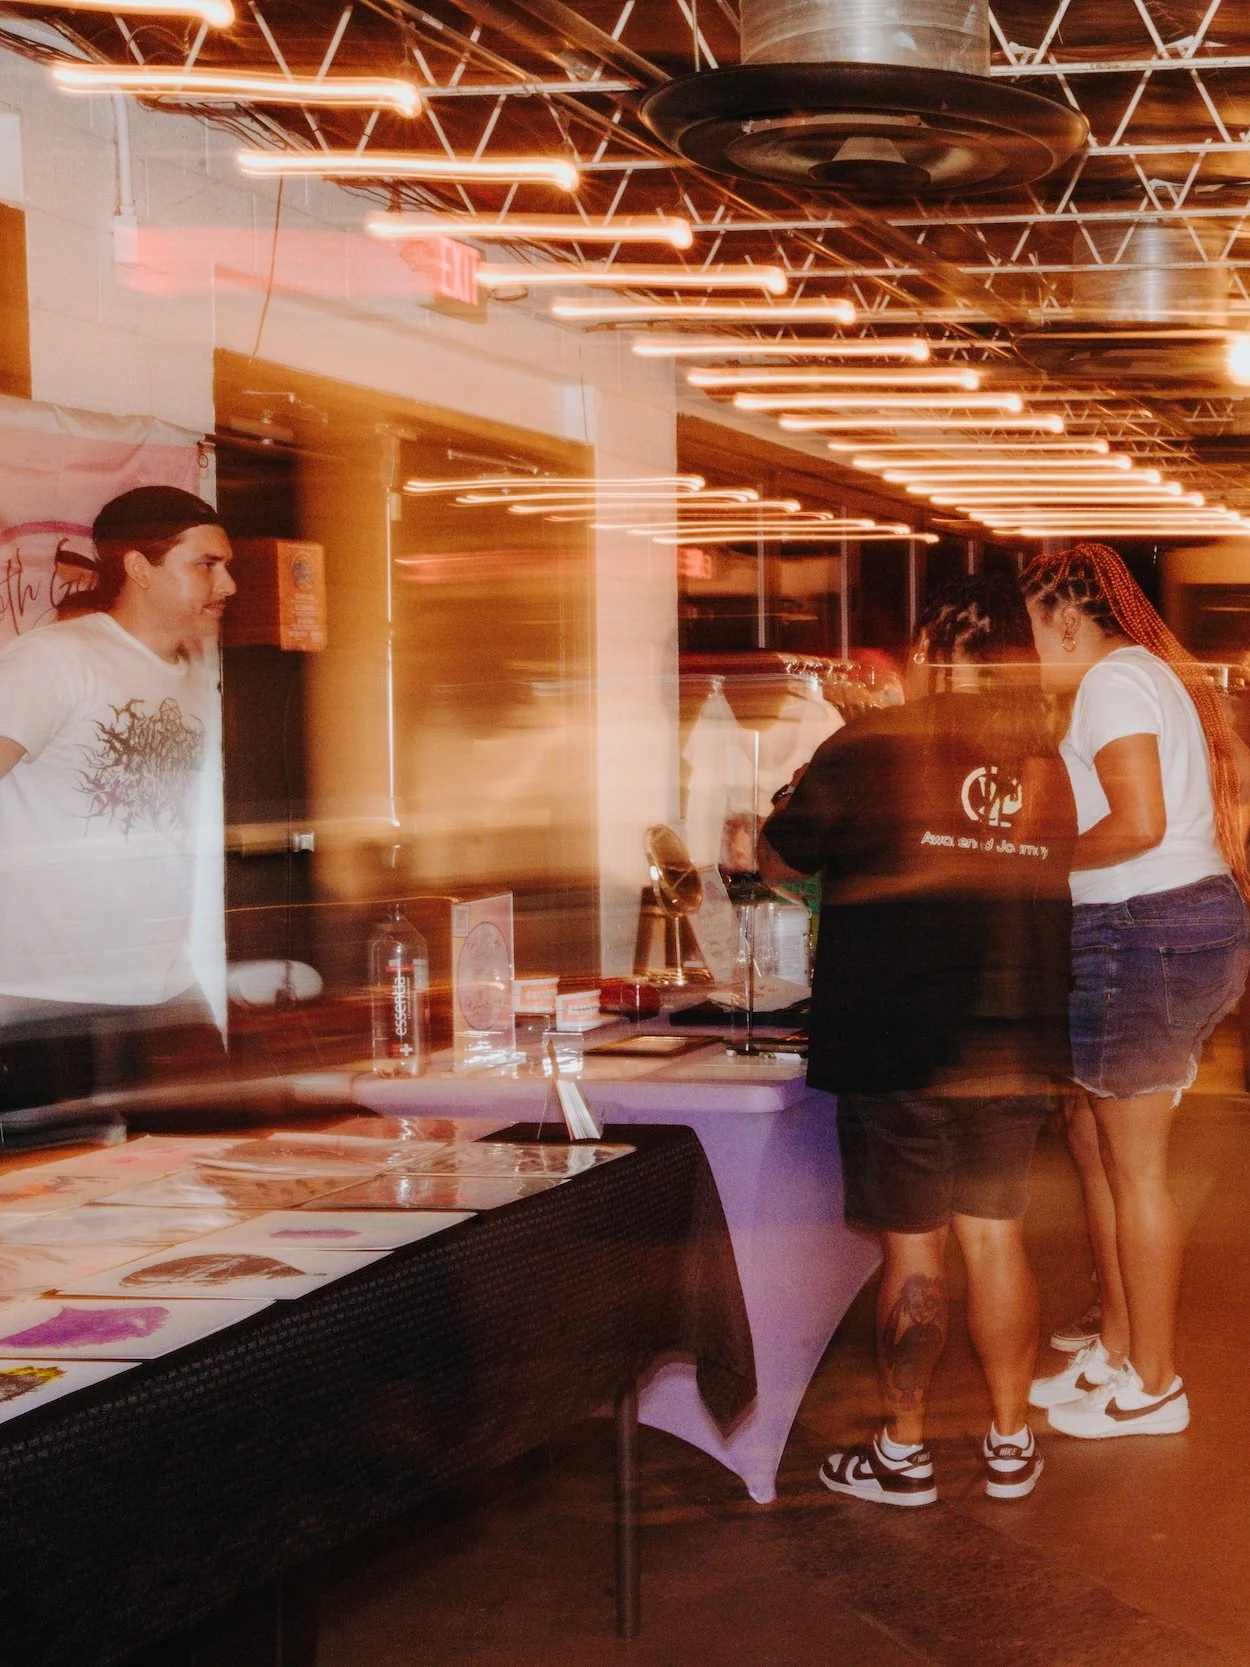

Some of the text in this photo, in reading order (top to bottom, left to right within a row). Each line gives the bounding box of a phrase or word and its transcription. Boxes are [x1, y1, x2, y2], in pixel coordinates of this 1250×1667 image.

[440, 236, 479, 306] EXIT
[391, 975, 408, 1037] essentia
[999, 1447, 1017, 1457] NIKE
